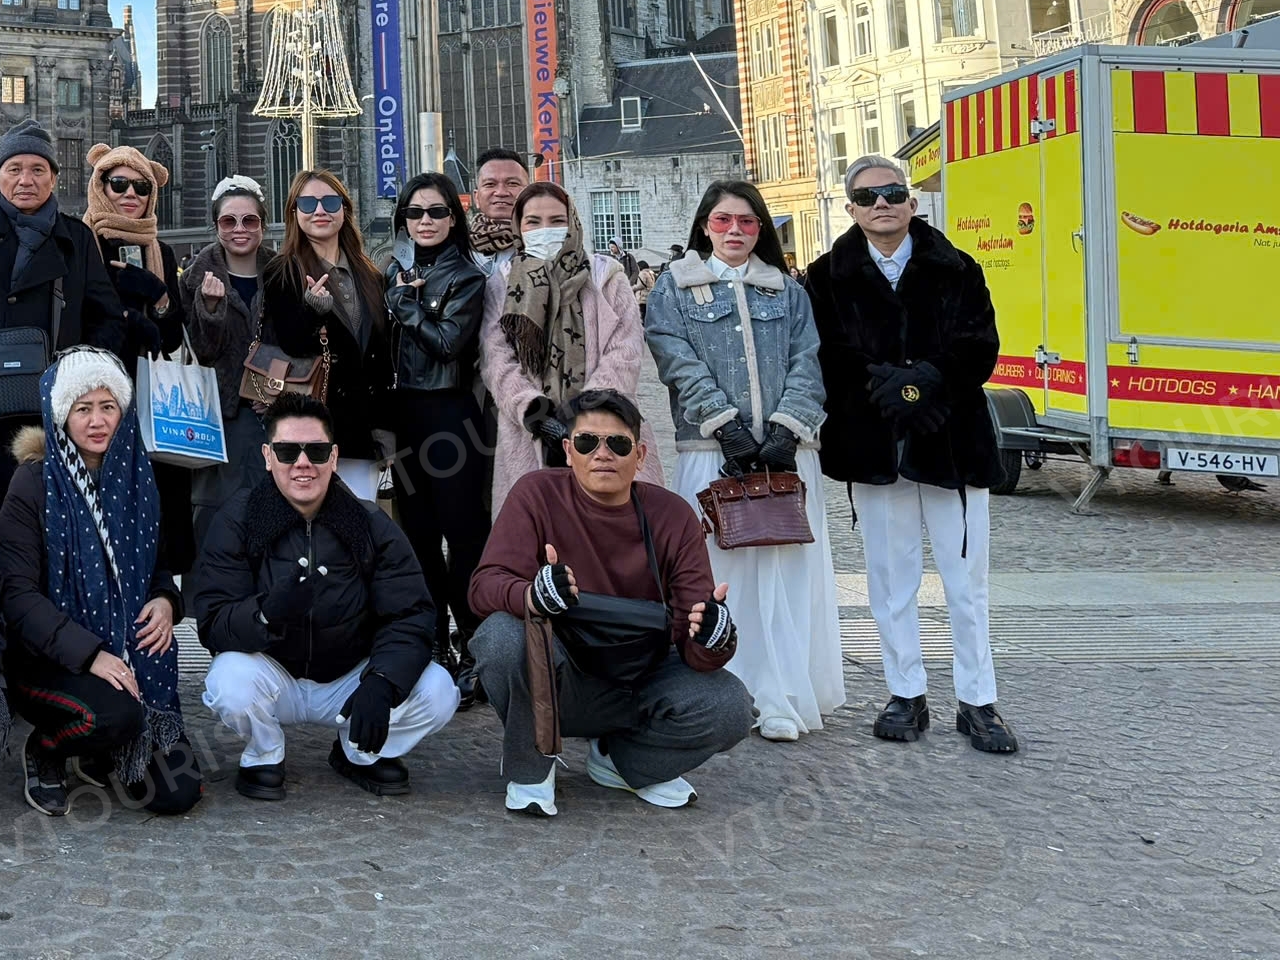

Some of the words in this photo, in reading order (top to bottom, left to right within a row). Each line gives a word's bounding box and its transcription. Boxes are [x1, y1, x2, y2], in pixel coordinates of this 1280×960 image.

[536, 91, 560, 153] Kerk
[378, 95, 400, 191] Ontdek
[956, 214, 991, 233] Hotdogeria
[1167, 218, 1249, 235] Hotdogeria
[976, 234, 1014, 251] Amsterdam
[1253, 238, 1271, 247] Not
[1052, 368, 1077, 385] DRINKS
[1128, 376, 1217, 396] HOTDOGS
[1177, 451, 1268, 472] V-546-HV
